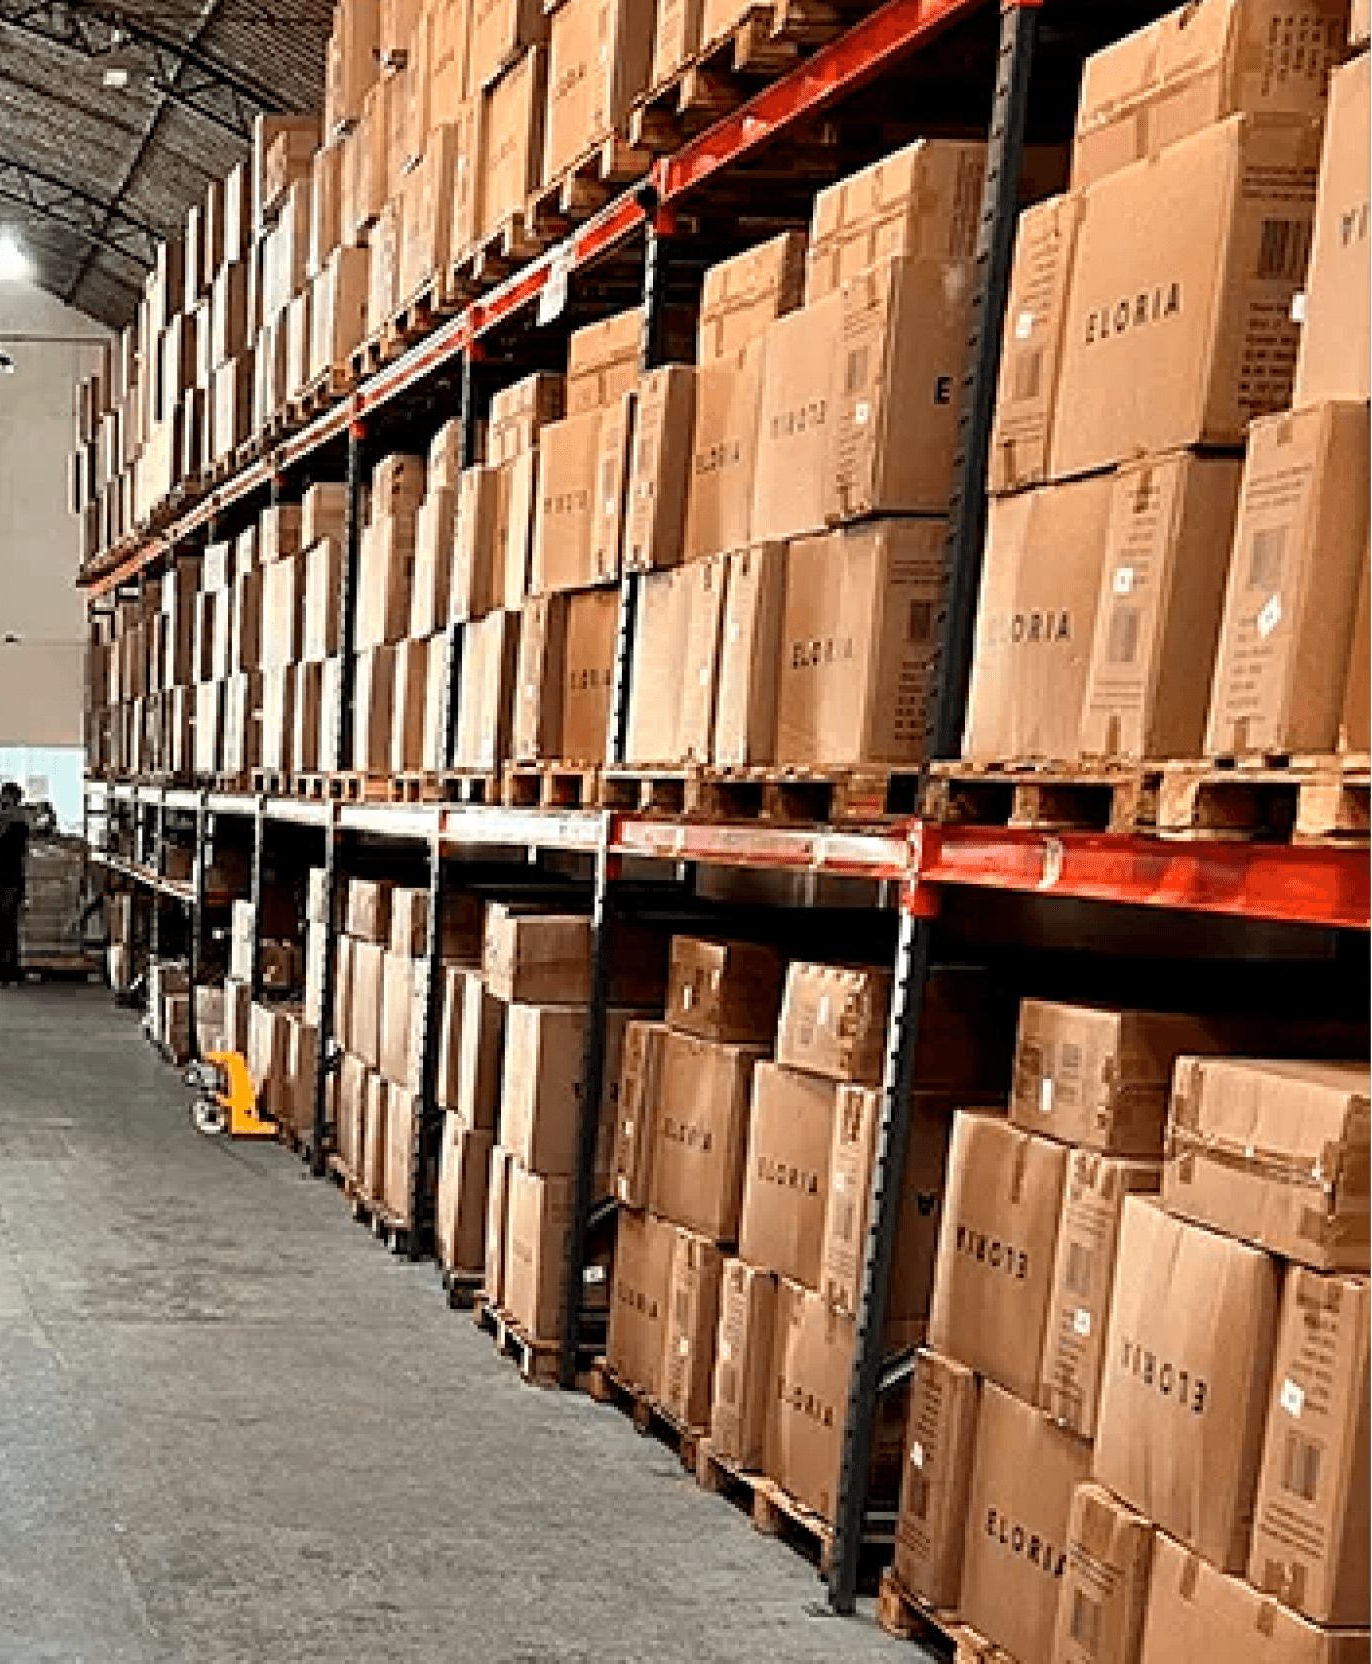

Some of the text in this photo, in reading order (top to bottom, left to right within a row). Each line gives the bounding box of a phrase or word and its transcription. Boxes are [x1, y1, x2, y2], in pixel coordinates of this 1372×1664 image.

[1085, 283, 1180, 345] ELORIA
[771, 400, 827, 439] ELORIA
[791, 638, 854, 669] ELORIA
[1010, 611, 1071, 644] ORIA
[757, 1156, 819, 1195] ELORIA
[957, 1225, 1030, 1280] ELORIA
[777, 1373, 834, 1427] ELORIA
[1121, 1339, 1208, 1415] ELORIA
[985, 1508, 1067, 1578] ELORIA
